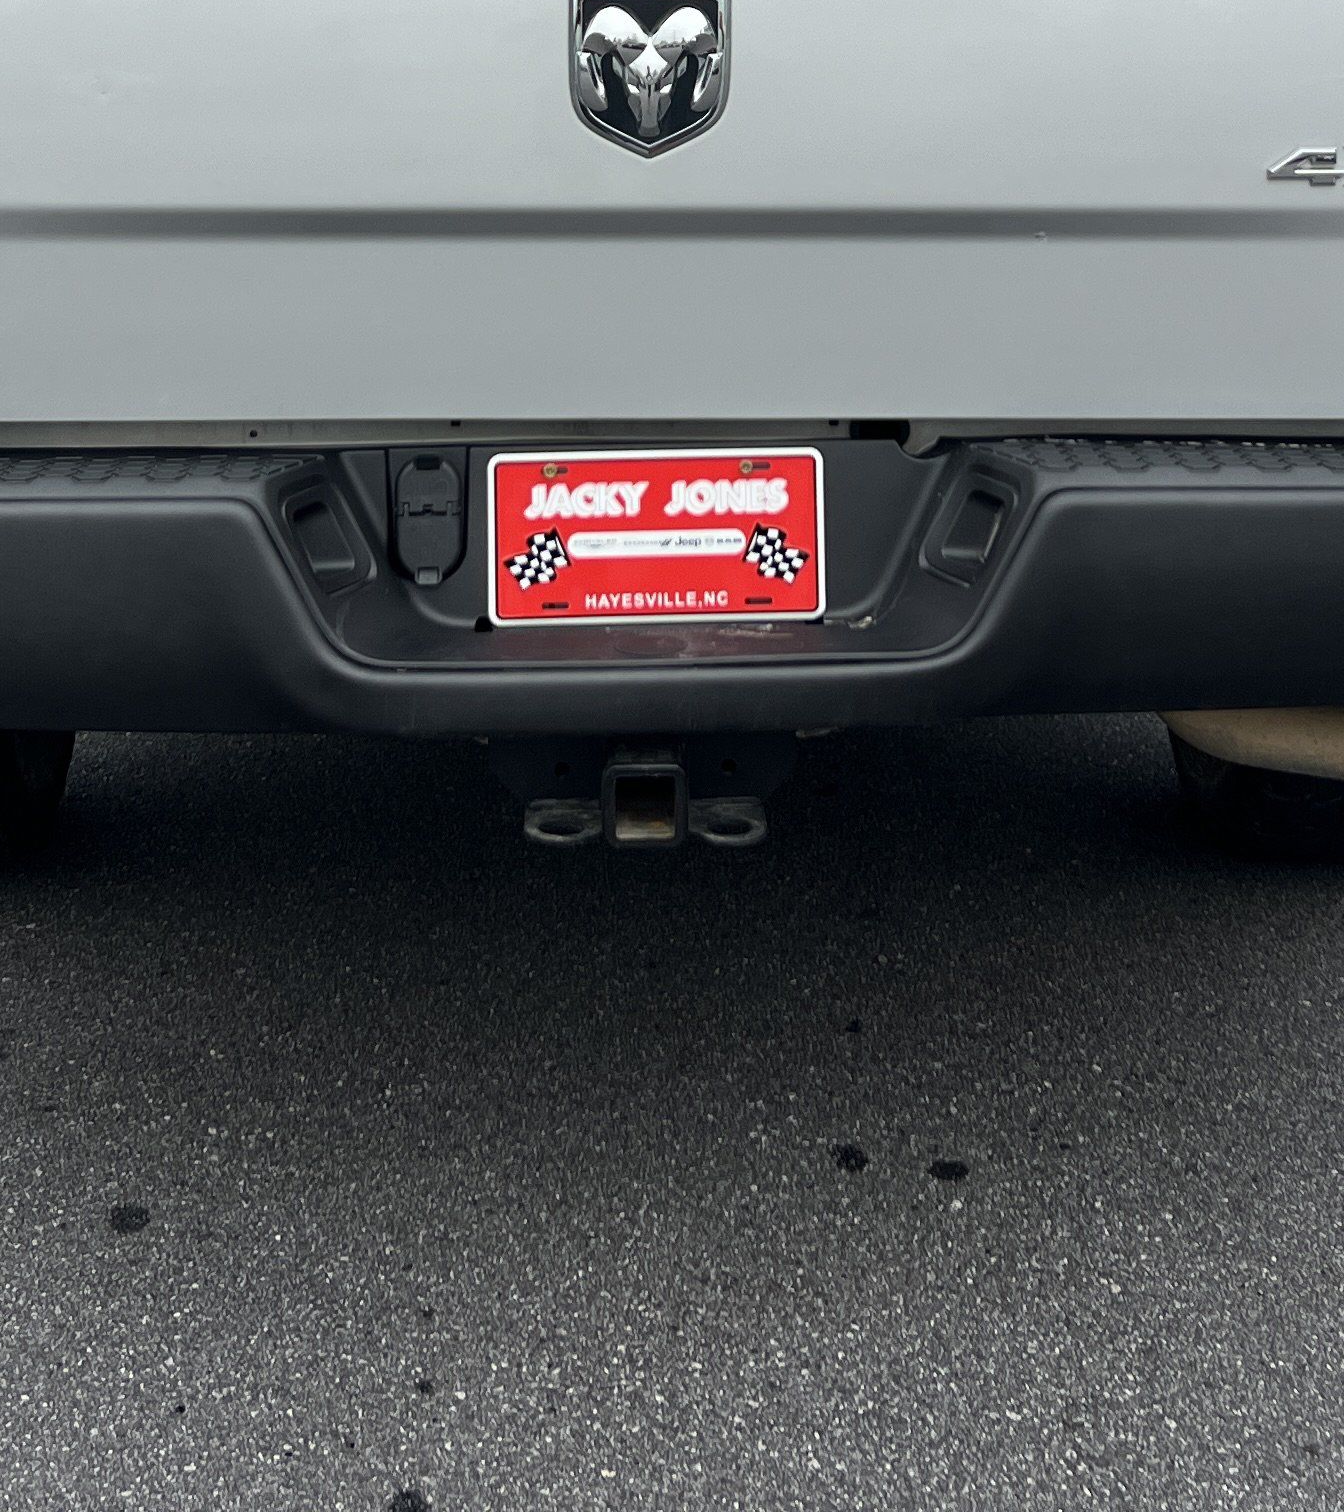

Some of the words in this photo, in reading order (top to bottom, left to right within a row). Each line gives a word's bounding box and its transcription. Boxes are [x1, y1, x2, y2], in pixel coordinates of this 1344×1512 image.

[523, 480, 650, 521] JACKY
[663, 478, 790, 518] JONES
[674, 535, 702, 547] Jeep
